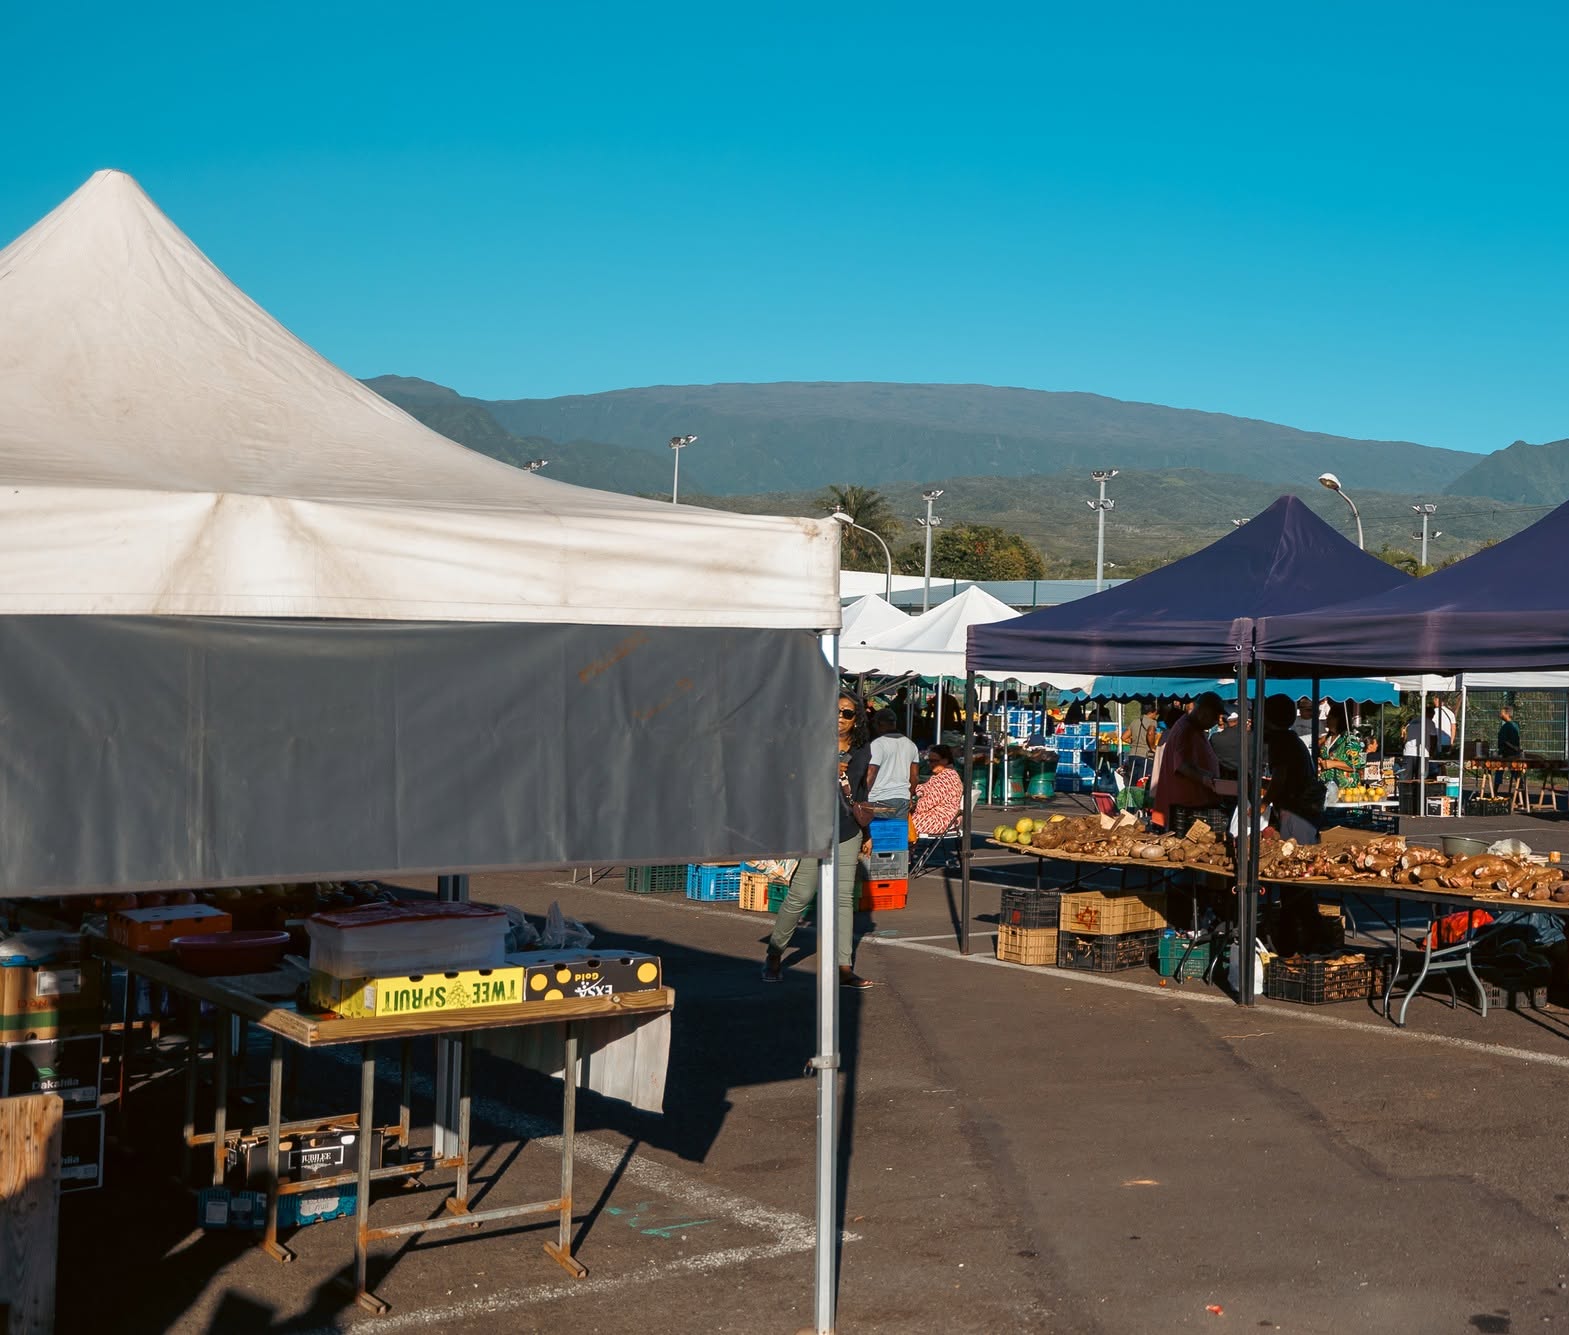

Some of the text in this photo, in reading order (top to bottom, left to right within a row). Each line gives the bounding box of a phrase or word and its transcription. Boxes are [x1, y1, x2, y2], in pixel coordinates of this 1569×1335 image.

[574, 972, 600, 982] Gold
[382, 986, 446, 1013] SPRUIT
[472, 979, 517, 1004] TWEE
[302, 1152, 332, 1163] JUBILEE
